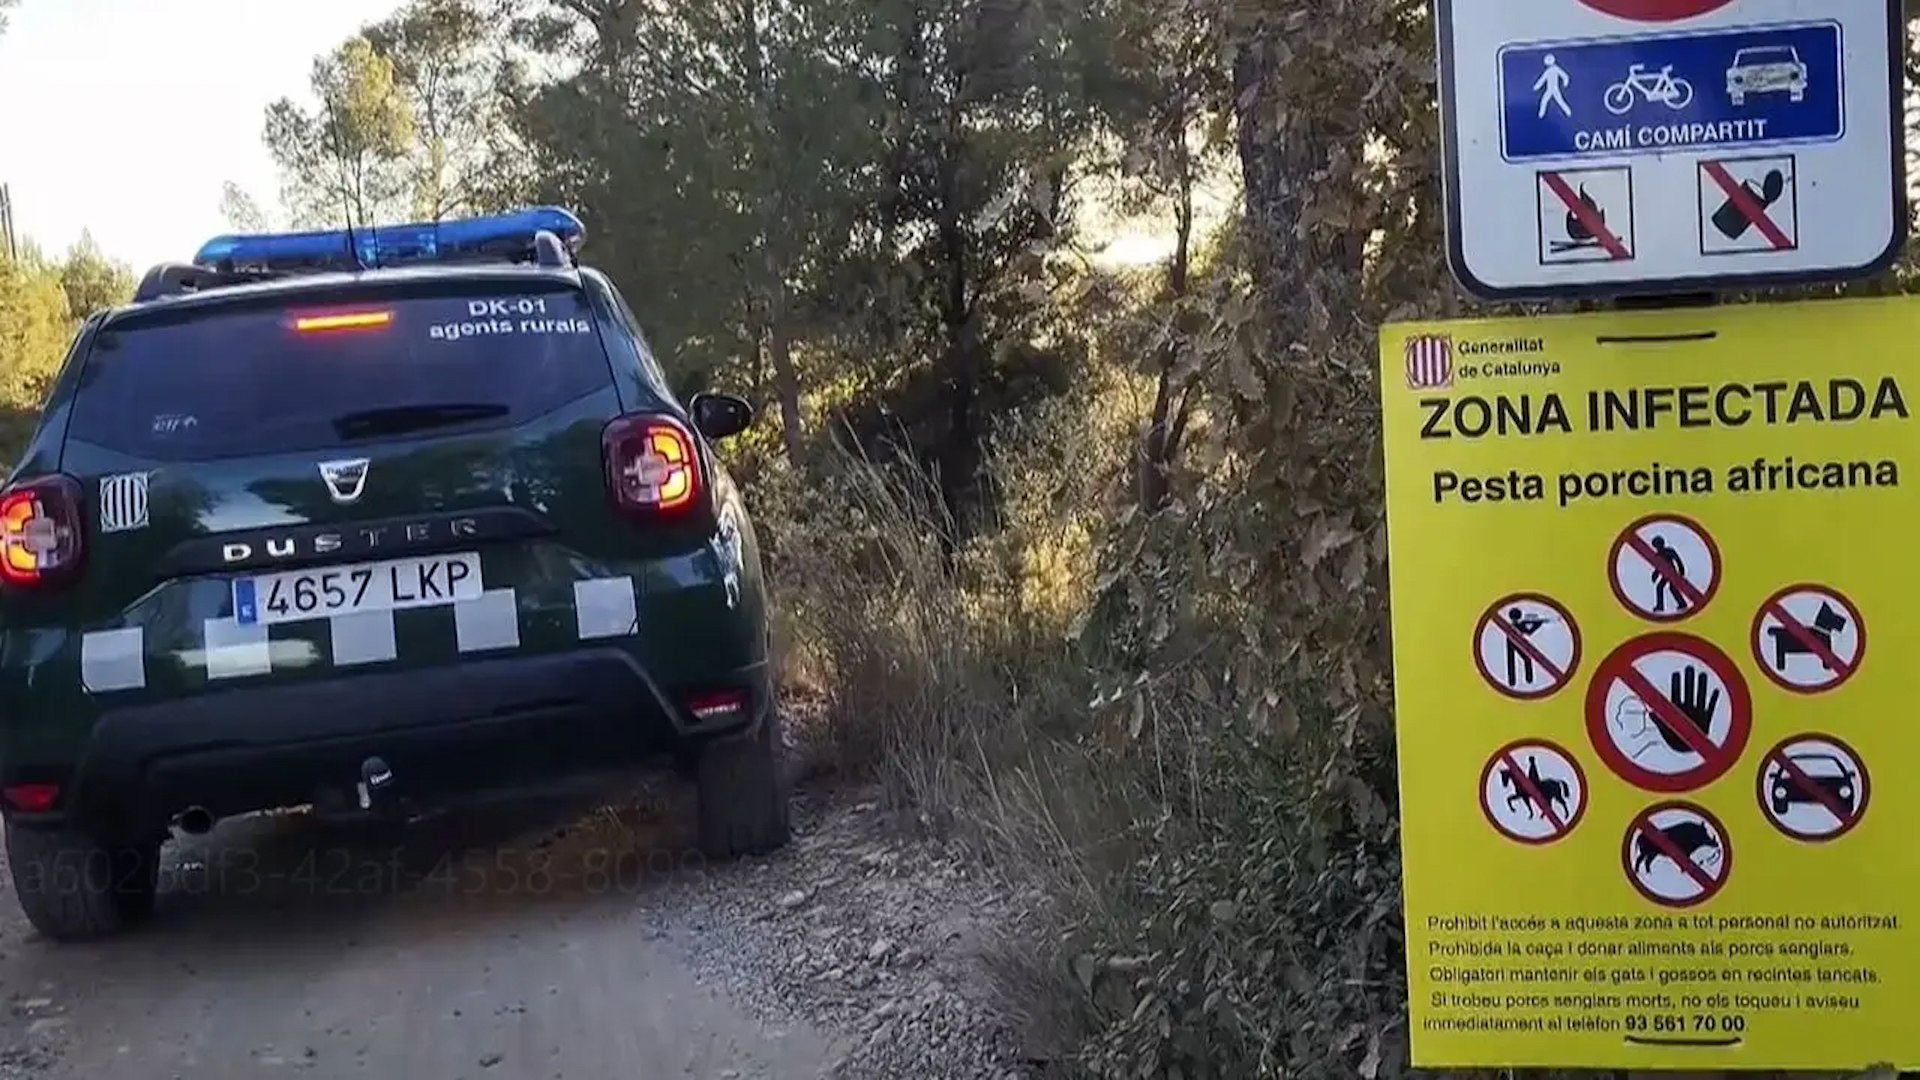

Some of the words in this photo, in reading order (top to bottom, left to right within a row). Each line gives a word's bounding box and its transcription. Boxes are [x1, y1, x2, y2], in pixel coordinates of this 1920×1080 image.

[1574, 123, 1632, 151] CAMÍ
[1638, 119, 1767, 147] COMPARTIT
[467, 298, 546, 317] DK-01
[429, 318, 513, 341] agents
[520, 318, 591, 334] rurals
[1458, 337, 1544, 356] Generalitat
[1459, 365, 1478, 379] de
[1482, 361, 1561, 377] Catalunya
[1420, 396, 1572, 439] ZONA
[1588, 377, 1909, 433] INFECTADA
[1433, 470, 1544, 503] Pesta
[1559, 462, 1714, 506] porcina
[1727, 456, 1898, 491] africana
[222, 517, 478, 563] DUSTER
[266, 569, 372, 615] 4657
[391, 560, 470, 603] LKP
[1428, 916, 1487, 931] Prohibit
[1491, 916, 1546, 931] l'accés
[1565, 915, 1628, 932] aquesta
[1633, 918, 1672, 929] zona
[1693, 915, 1713, 929] tot
[1718, 915, 1789, 932] personal
[1795, 917, 1815, 929] no
[1821, 915, 1901, 929] autoritzat.
[1429, 941, 1502, 956] Prohibida
[1508, 941, 1521, 955] la
[1526, 943, 1563, 959] caça
[1577, 941, 1623, 955] donar
[1628, 941, 1695, 955] aliments
[1701, 941, 1723, 955] als
[1729, 943, 1774, 958] porcs
[1779, 941, 1854, 959] senglars.
[1430, 967, 1504, 985] Obligatori
[1510, 968, 1577, 982] mantenir
[1583, 967, 1606, 981] els
[1611, 968, 1645, 985] gats
[1659, 969, 1716, 985] gossos
[1722, 969, 1742, 981] en
[1747, 967, 1812, 981] recintes
[1817, 967, 1882, 983] tancats.
[1431, 991, 1447, 1007] Si
[1451, 992, 1500, 1008] trobeu
[1505, 994, 1549, 1010] porcs
[1554, 992, 1621, 1010] senglars
[1626, 993, 1676, 1009] morts,
[1681, 995, 1701, 1008] no
[1706, 993, 1730, 1008] els
[1735, 993, 1790, 1011] toqueu
[1805, 993, 1860, 1008] aviseu
[1423, 1016, 1544, 1031] immediatament
[1548, 1016, 1561, 1030] al
[1567, 1015, 1620, 1031] telèfon
[1624, 1014, 1647, 1031] 93
[1653, 1014, 1686, 1031] 561
[1692, 1014, 1716, 1031] 70
